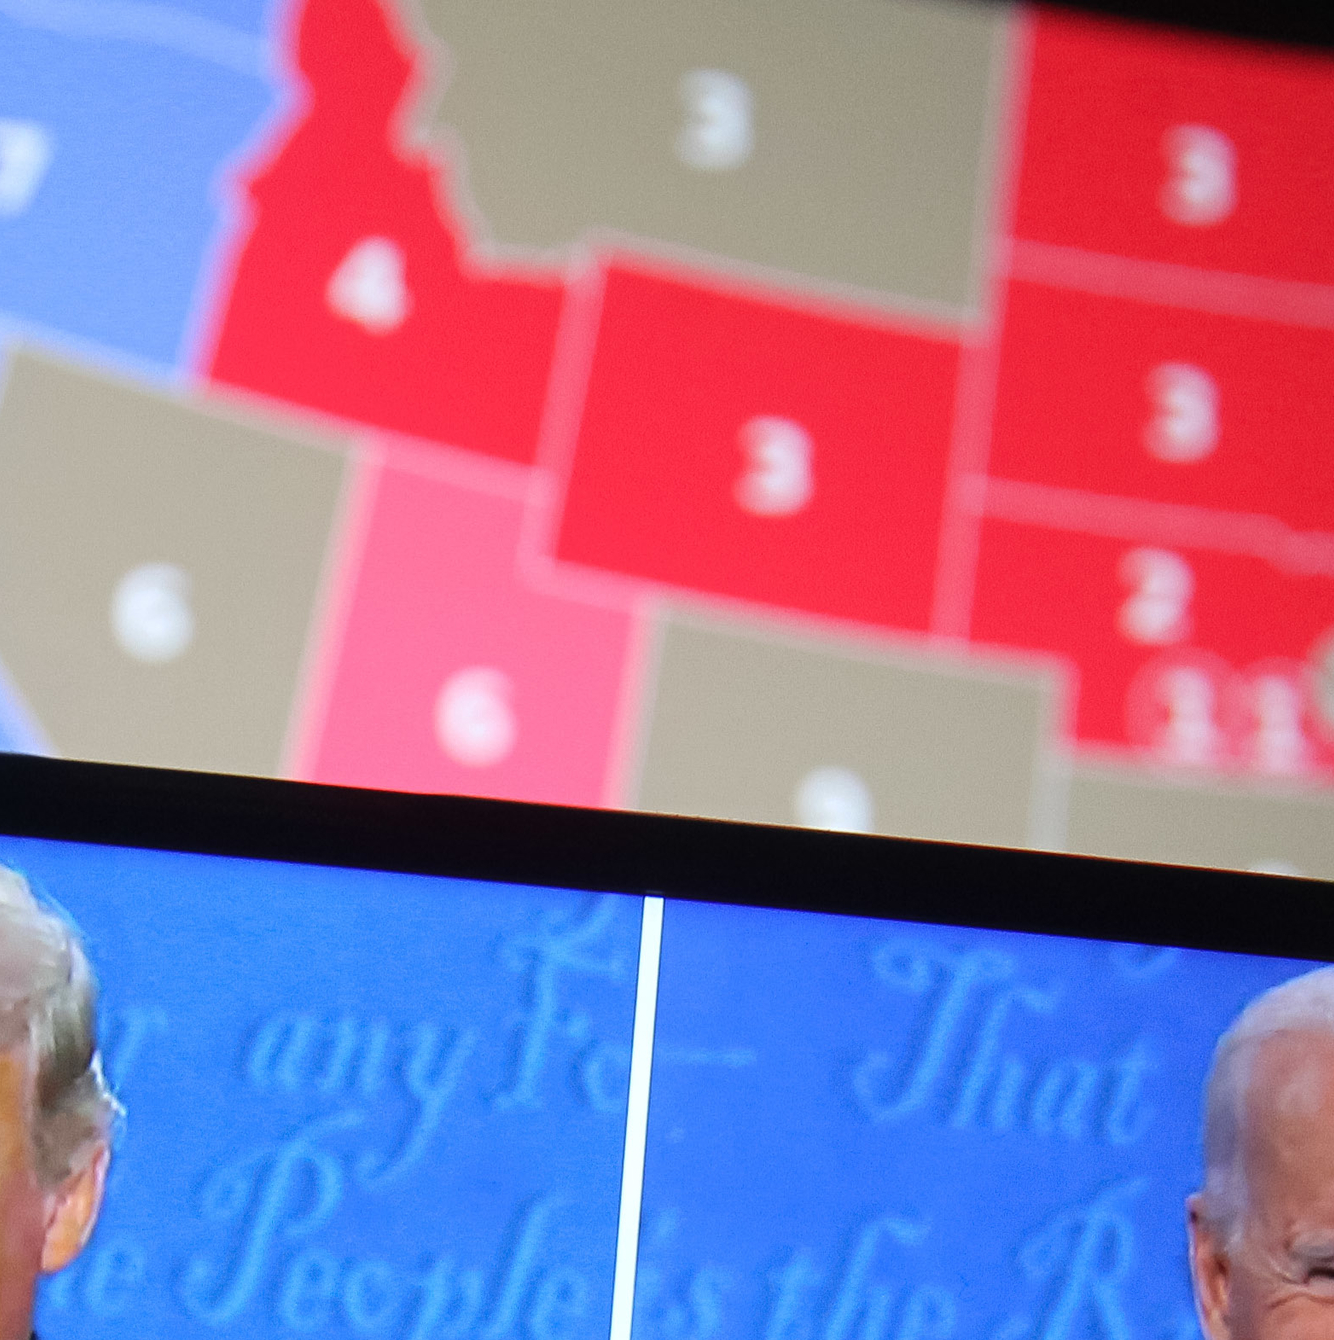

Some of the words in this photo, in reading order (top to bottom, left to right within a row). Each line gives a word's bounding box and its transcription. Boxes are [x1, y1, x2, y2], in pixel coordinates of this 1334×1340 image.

[677, 66, 755, 171] 3
[1160, 123, 1237, 226] 3
[326, 237, 412, 335] 4
[1143, 361, 1219, 464] 3
[734, 415, 814, 518] 3
[111, 561, 194, 663] 6
[435, 665, 516, 767] 6
[854, 936, 1162, 1145] That
[247, 1010, 467, 1190] any
